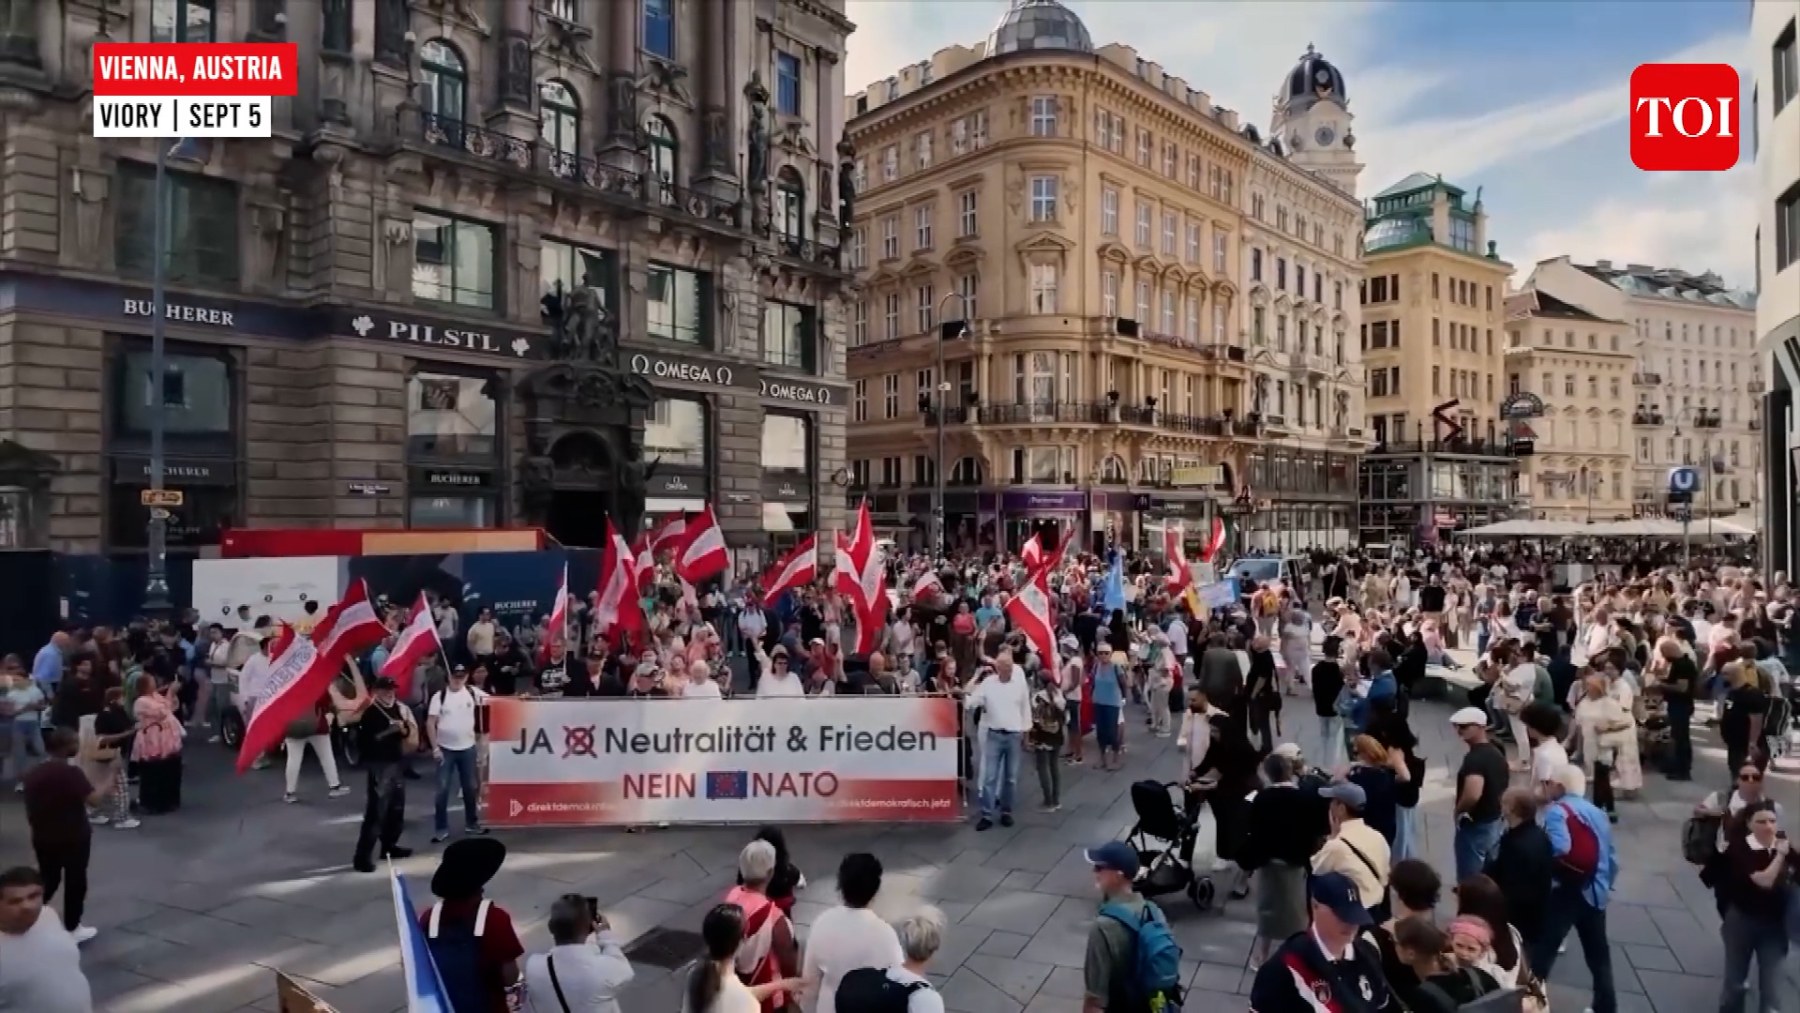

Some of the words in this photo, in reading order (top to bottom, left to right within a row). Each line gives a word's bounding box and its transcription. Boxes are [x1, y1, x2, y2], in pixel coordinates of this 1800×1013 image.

[124, 299, 234, 326] BUHERER
[388, 320, 500, 351] PILSTL
[654, 360, 712, 382] OMEGA
[770, 384, 814, 402] OMEGA
[431, 473, 481, 485] BUCHERER
[1674, 472, 1694, 490] U
[511, 727, 554, 755] JA
[604, 724, 776, 754] Neutralität
[786, 725, 808, 752] &
[820, 724, 936, 752] Frieden
[623, 773, 696, 799] NEIN
[752, 771, 839, 798] NATO
